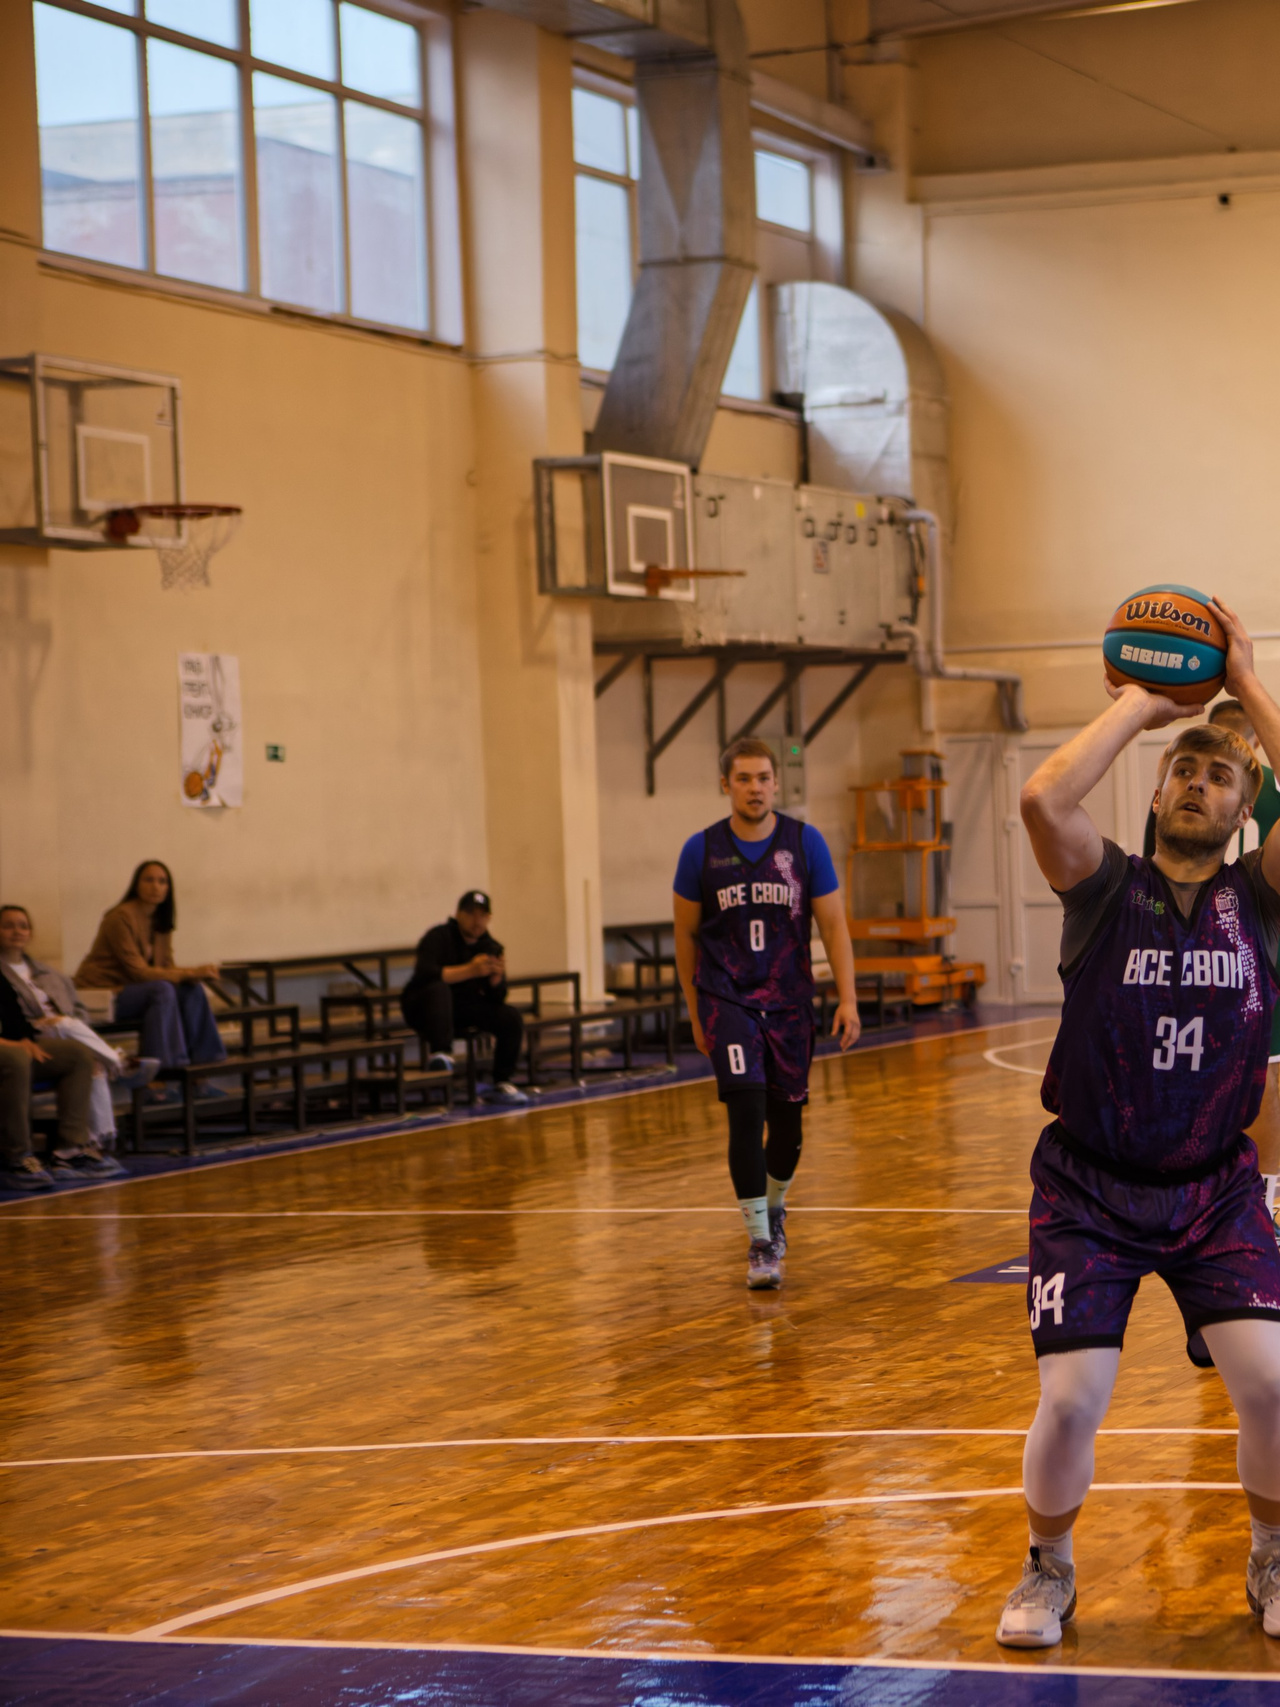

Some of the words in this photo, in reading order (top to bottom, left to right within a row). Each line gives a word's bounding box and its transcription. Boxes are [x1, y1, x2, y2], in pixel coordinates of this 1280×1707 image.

[1125, 600, 1211, 637] Wilson
[1120, 644, 1184, 670] SIBUR
[717, 883, 747, 912] ВСЕ
[750, 919, 765, 952] 0
[1123, 949, 1173, 986] ВСЕ
[1181, 950, 1243, 989] СВОИ
[727, 1044, 746, 1075] 0
[1153, 1015, 1204, 1071] 34
[1030, 1272, 1066, 1331] 34
